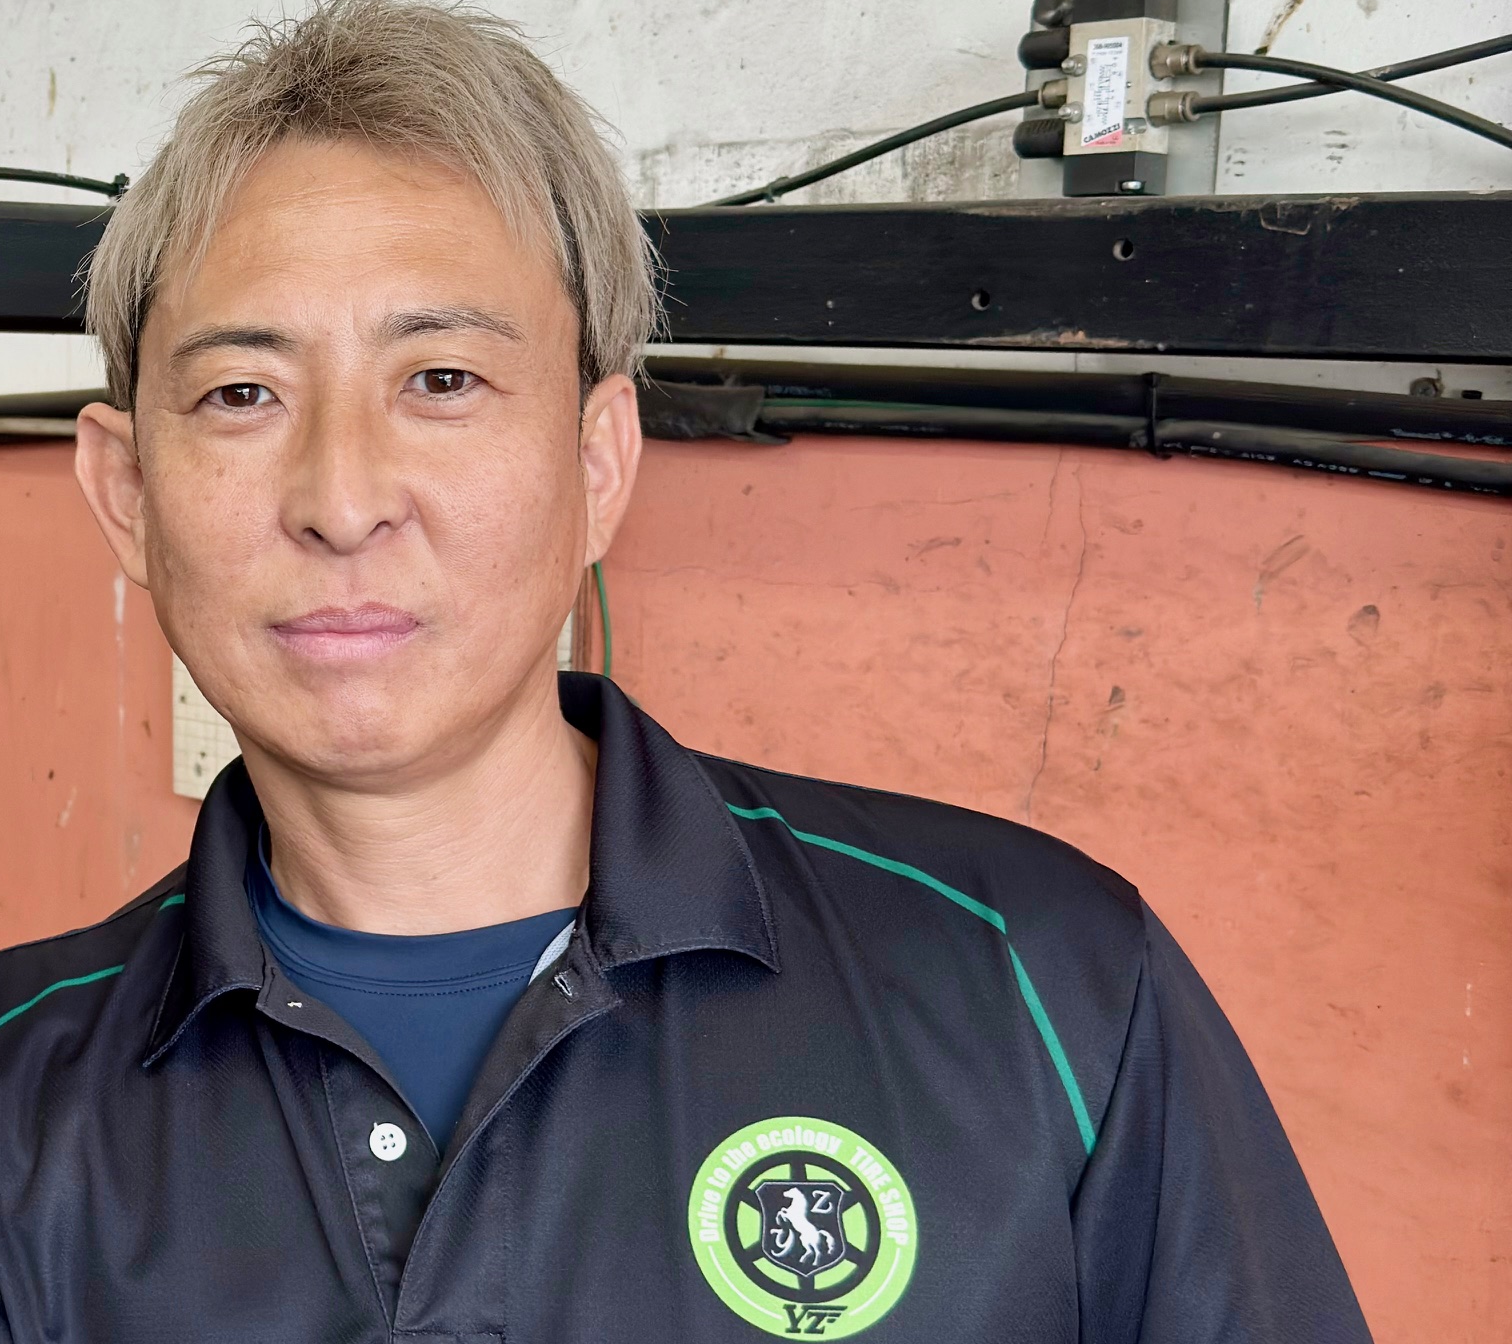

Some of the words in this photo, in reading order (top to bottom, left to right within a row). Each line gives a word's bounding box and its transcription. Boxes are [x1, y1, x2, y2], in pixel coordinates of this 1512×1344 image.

[720, 1140, 758, 1172] the
[755, 1124, 844, 1156] ecology
[706, 1166, 733, 1190] to
[849, 1145, 893, 1192] TIRE
[697, 1189, 722, 1243] Drive
[810, 1189, 834, 1215] Z
[878, 1187, 910, 1246] SHOP
